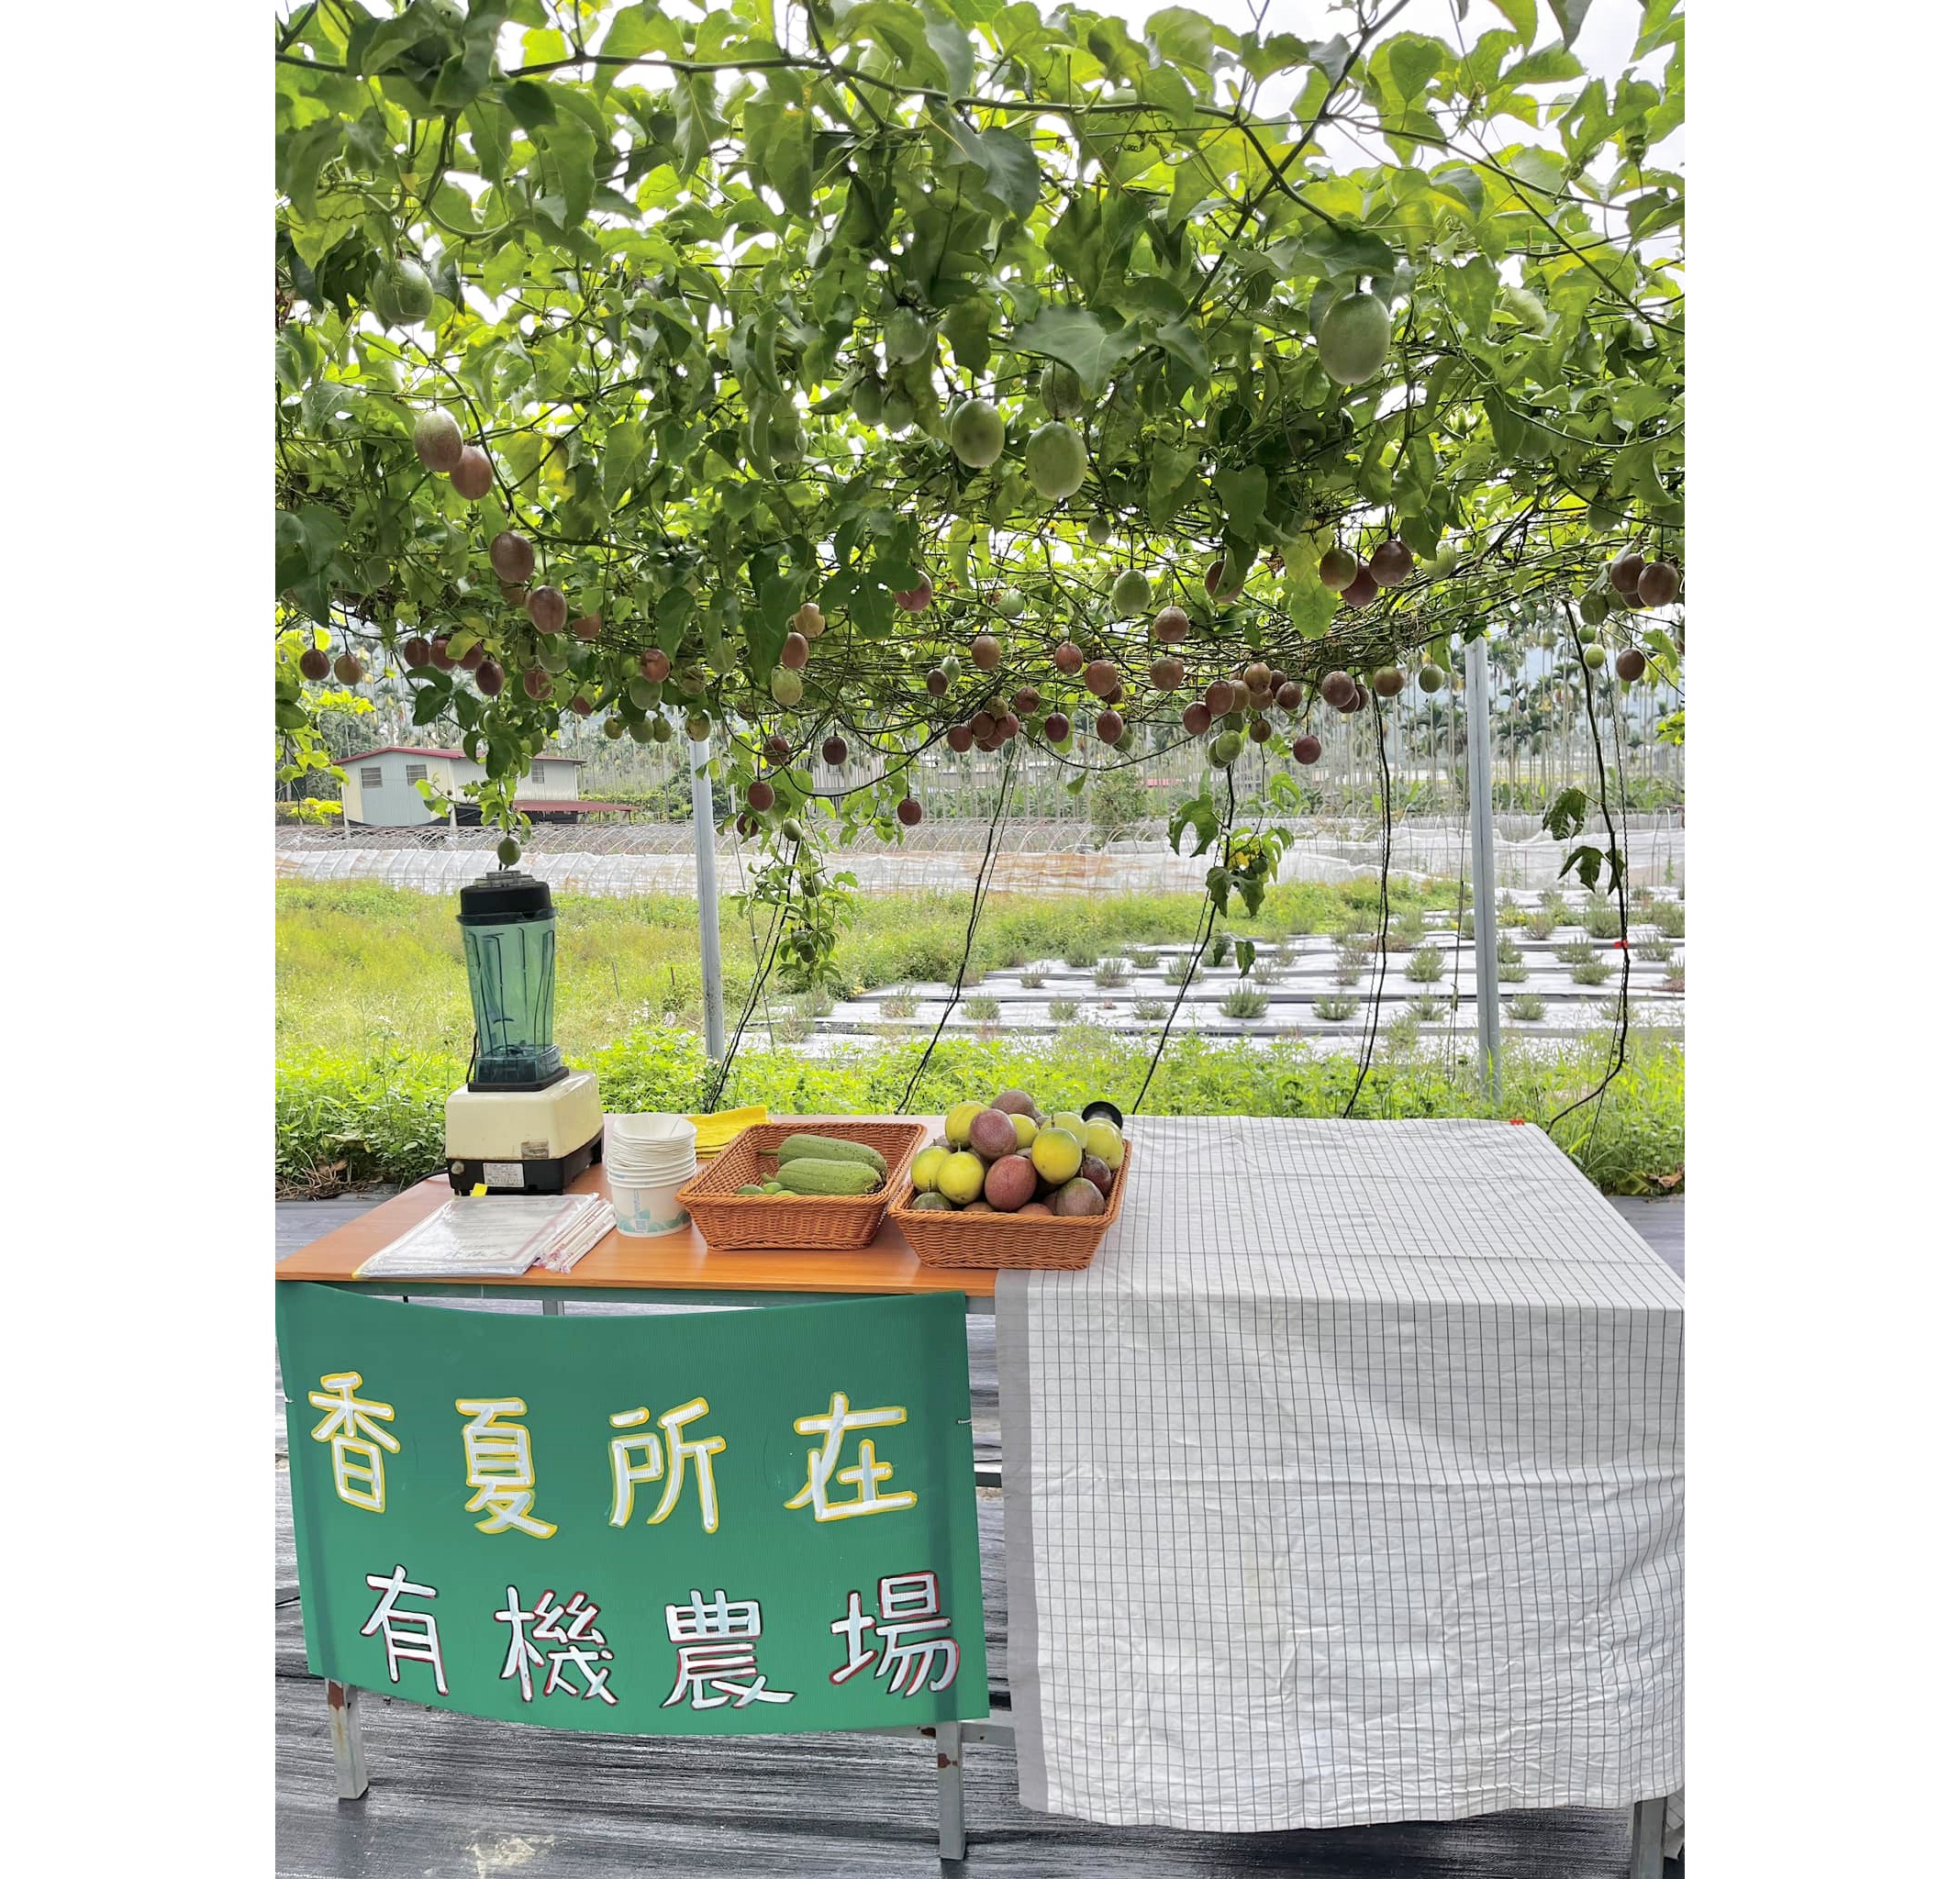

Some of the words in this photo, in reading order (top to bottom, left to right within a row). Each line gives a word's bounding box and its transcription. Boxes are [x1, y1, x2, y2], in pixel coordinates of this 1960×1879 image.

[308, 1371, 918, 1539] 香夏所在
[361, 1563, 961, 1710] 有機農場
